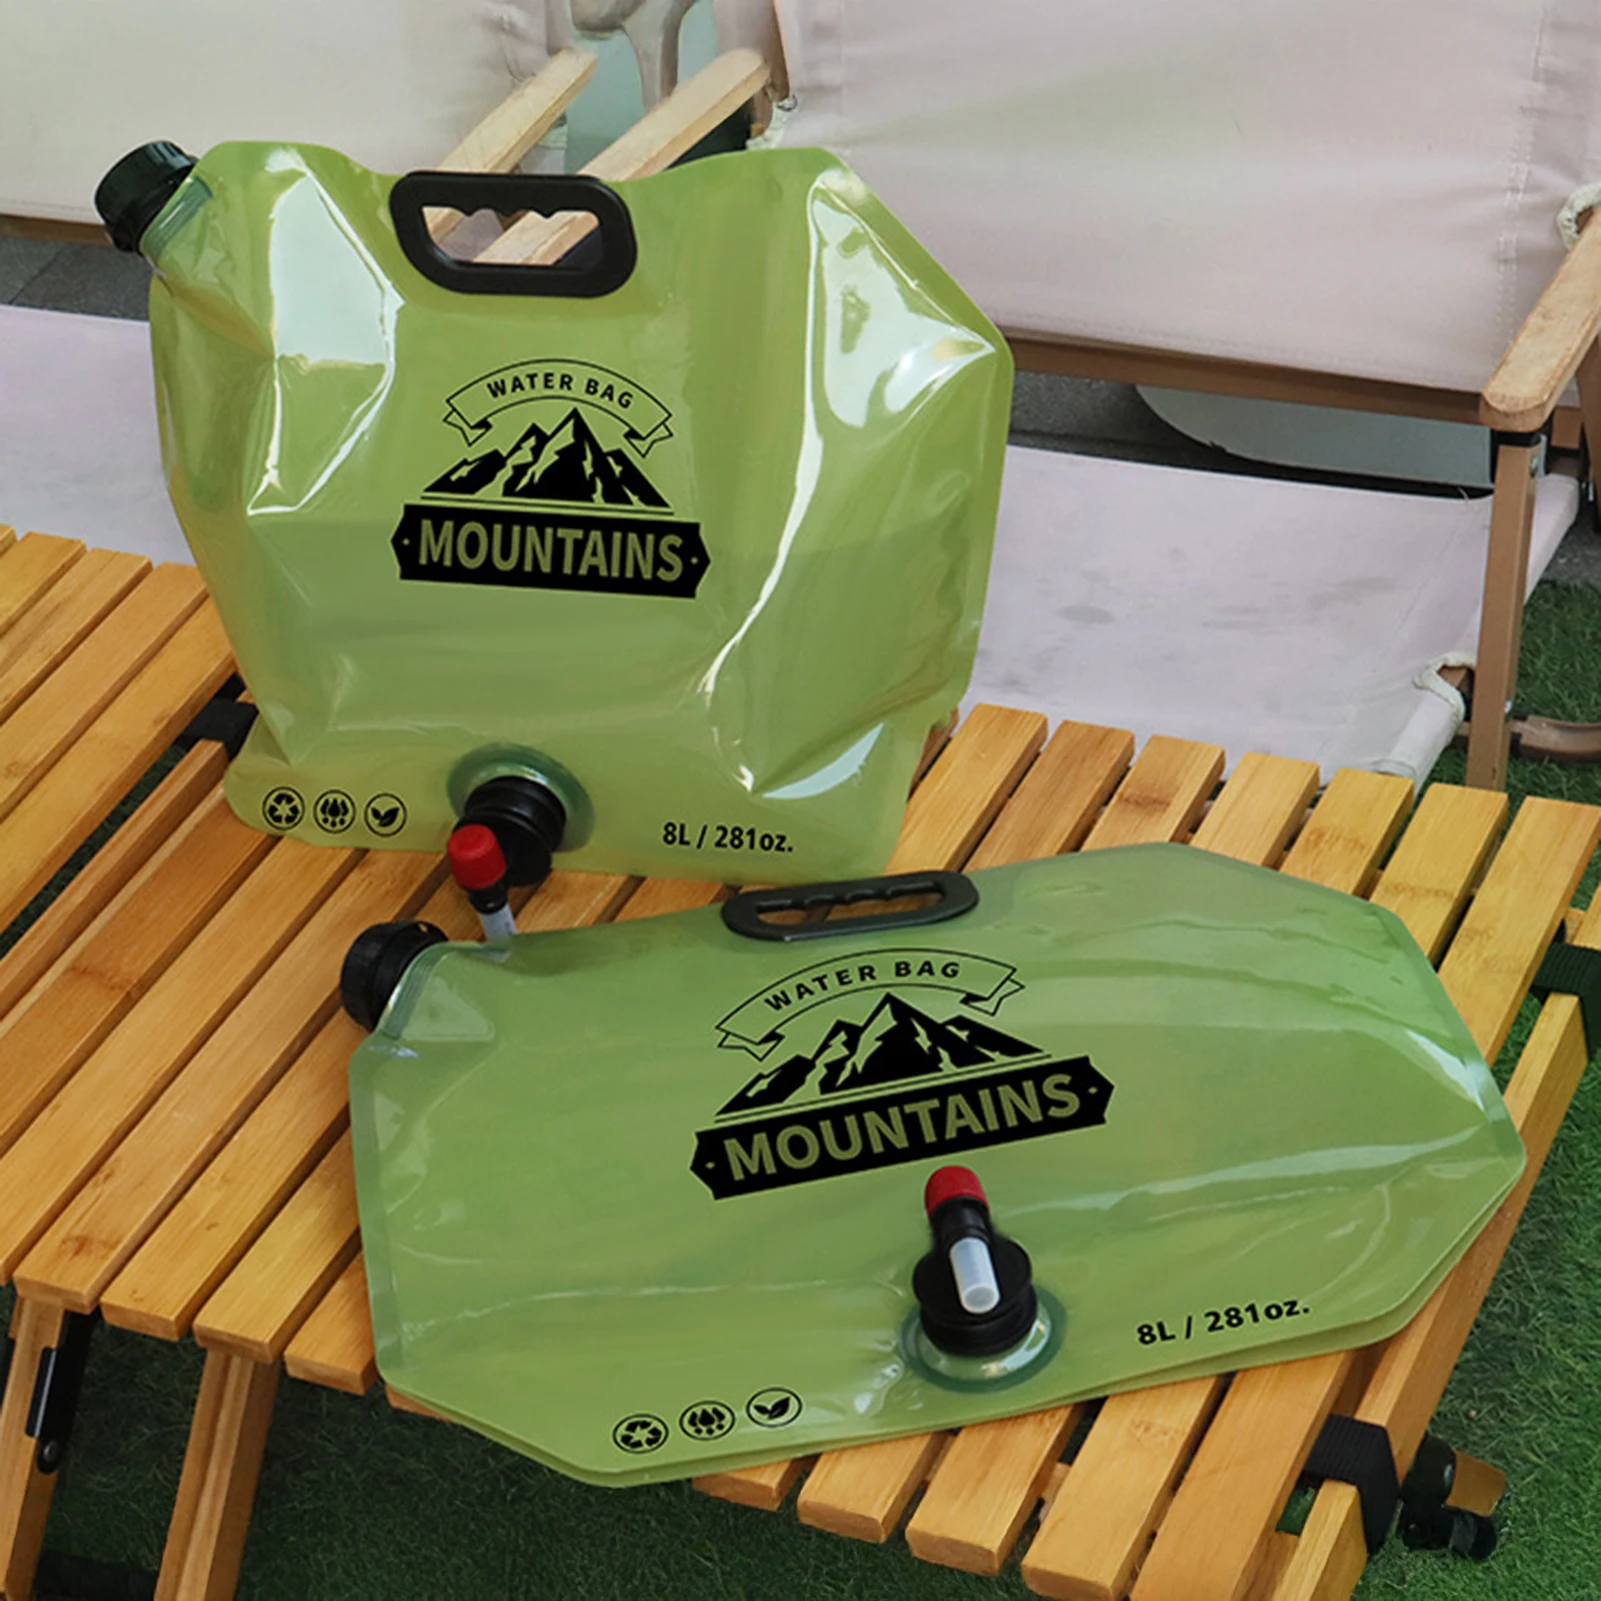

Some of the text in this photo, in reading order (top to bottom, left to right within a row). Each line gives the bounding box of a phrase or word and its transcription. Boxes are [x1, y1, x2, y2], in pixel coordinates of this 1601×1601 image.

[486, 372, 634, 409] WATER BAG
[418, 518, 684, 582] MOUNTAINS
[662, 821, 794, 853] 8L / 281oz.
[763, 960, 961, 1011] WATER BAG
[723, 1073, 1080, 1181] MOUNTAINS
[1136, 1299, 1311, 1345] 8L / 281oz.
